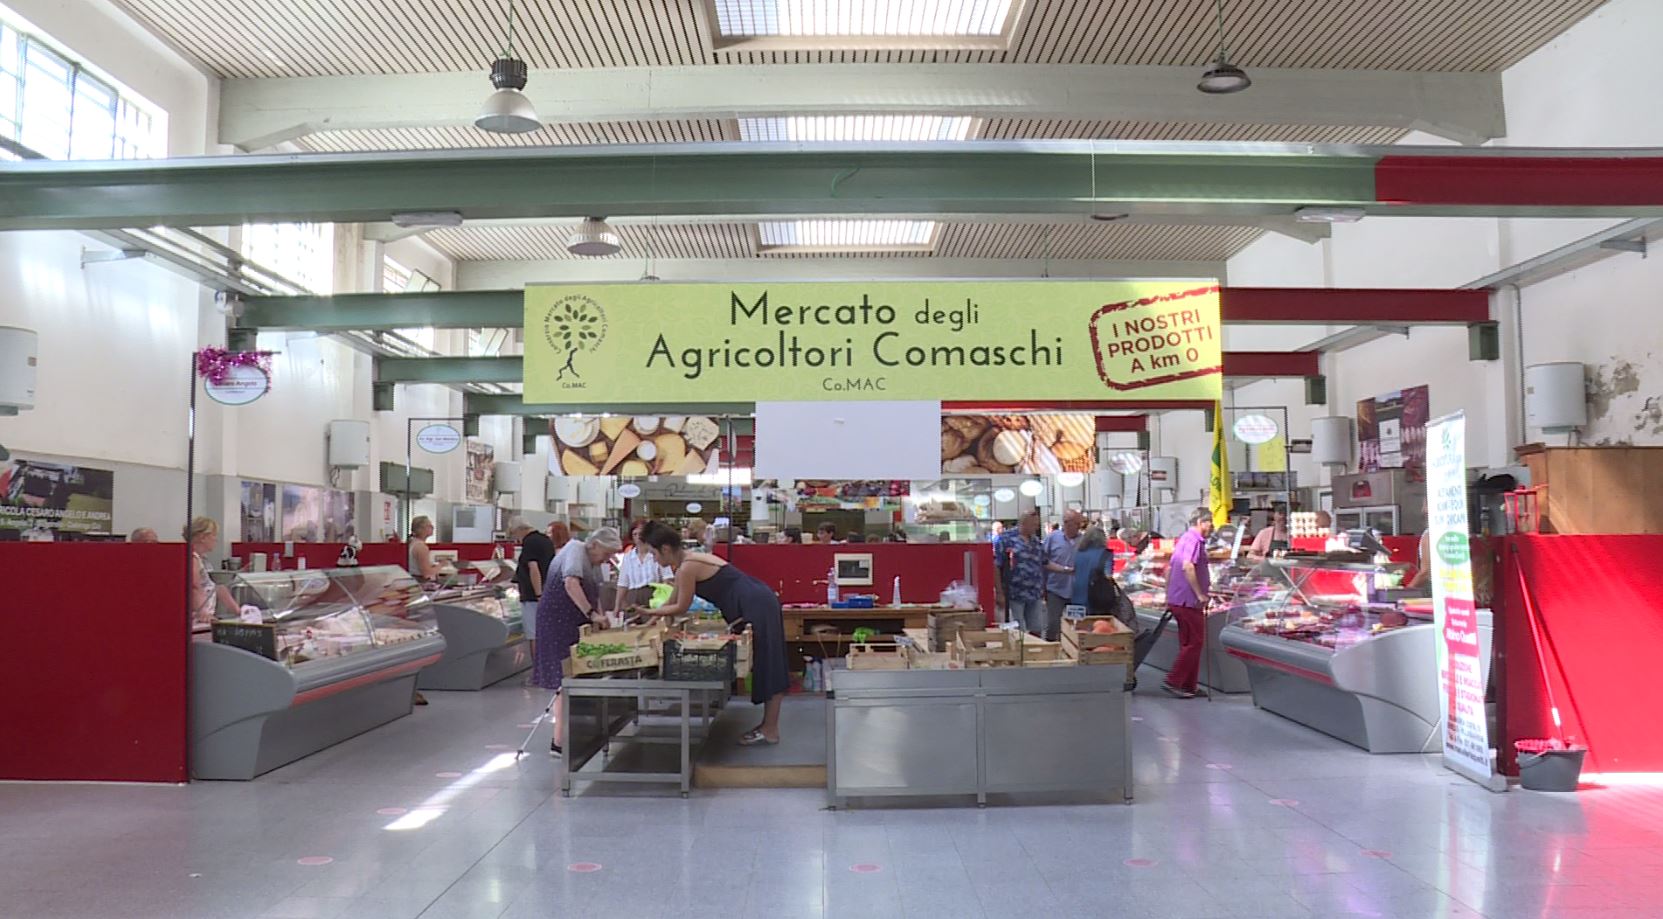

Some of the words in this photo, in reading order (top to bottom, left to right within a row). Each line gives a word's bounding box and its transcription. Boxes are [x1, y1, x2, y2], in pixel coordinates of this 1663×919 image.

[730, 290, 896, 325] Mercato
[915, 298, 978, 332] degli
[1112, 323, 1119, 338] I
[1124, 308, 1200, 336] NOSTRI
[646, 329, 852, 379] Agricoltori
[873, 329, 1063, 366] Comaschi
[1108, 325, 1212, 358] PRODOTTI
[1131, 357, 1145, 373] A
[1150, 353, 1180, 370] km
[822, 377, 886, 391] Co.MAC
[586, 655, 642, 669] CFERASTA
